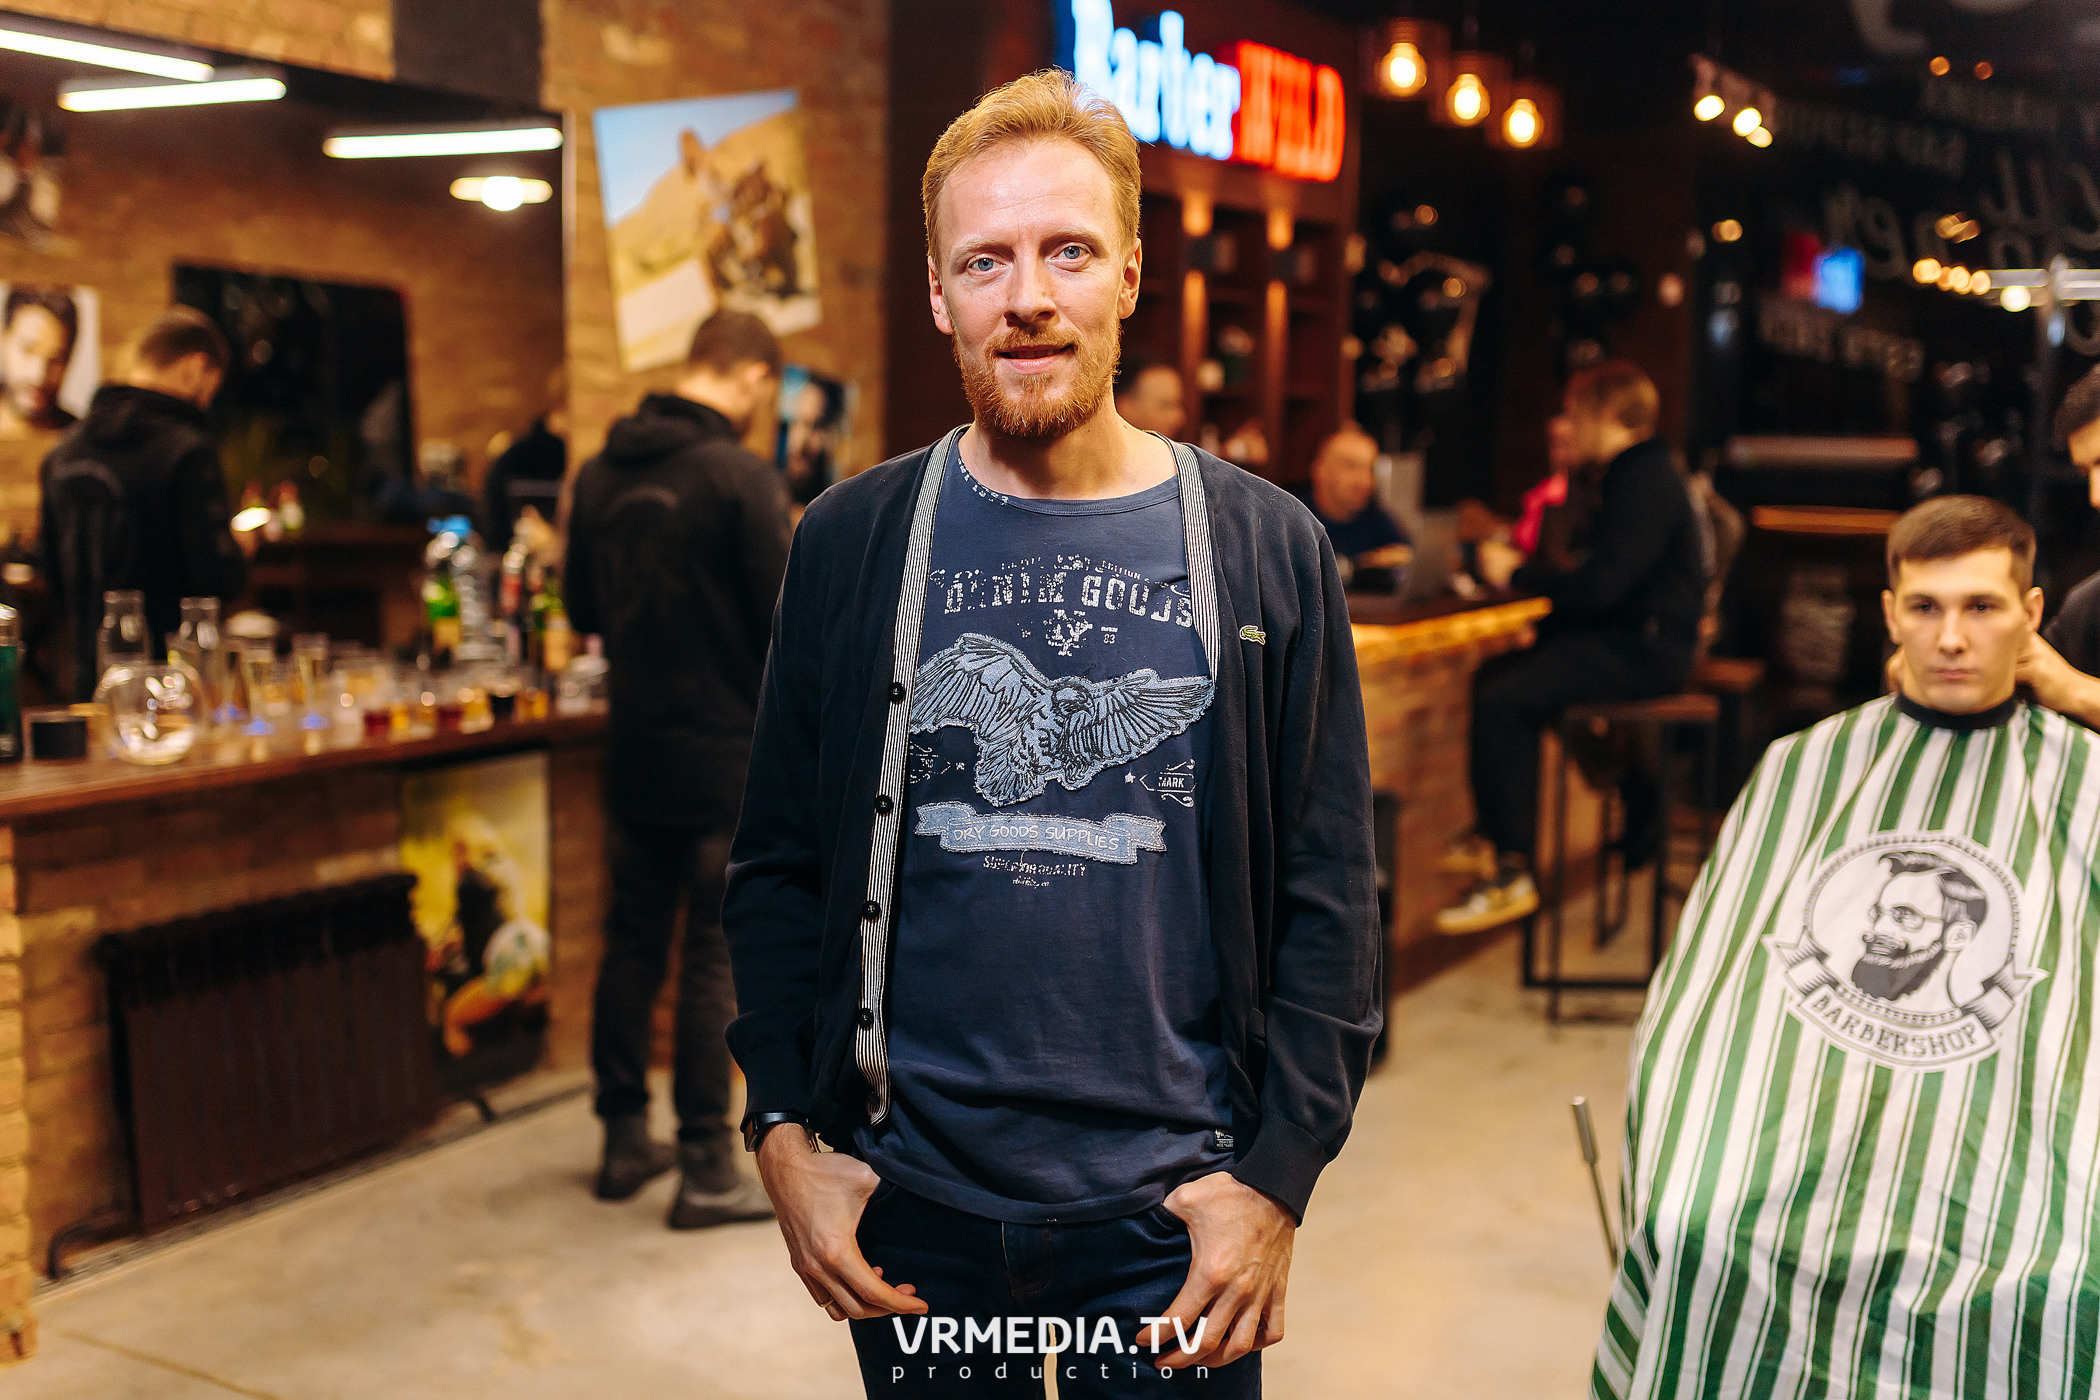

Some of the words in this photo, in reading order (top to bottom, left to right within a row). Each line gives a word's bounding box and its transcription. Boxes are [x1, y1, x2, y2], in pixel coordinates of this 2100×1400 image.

[952, 825, 986, 842] DRY
[989, 825, 1039, 839] GOODS
[1045, 826, 1120, 850] SUPPLIES
[1812, 994, 1977, 1057] BARBERSHOP
